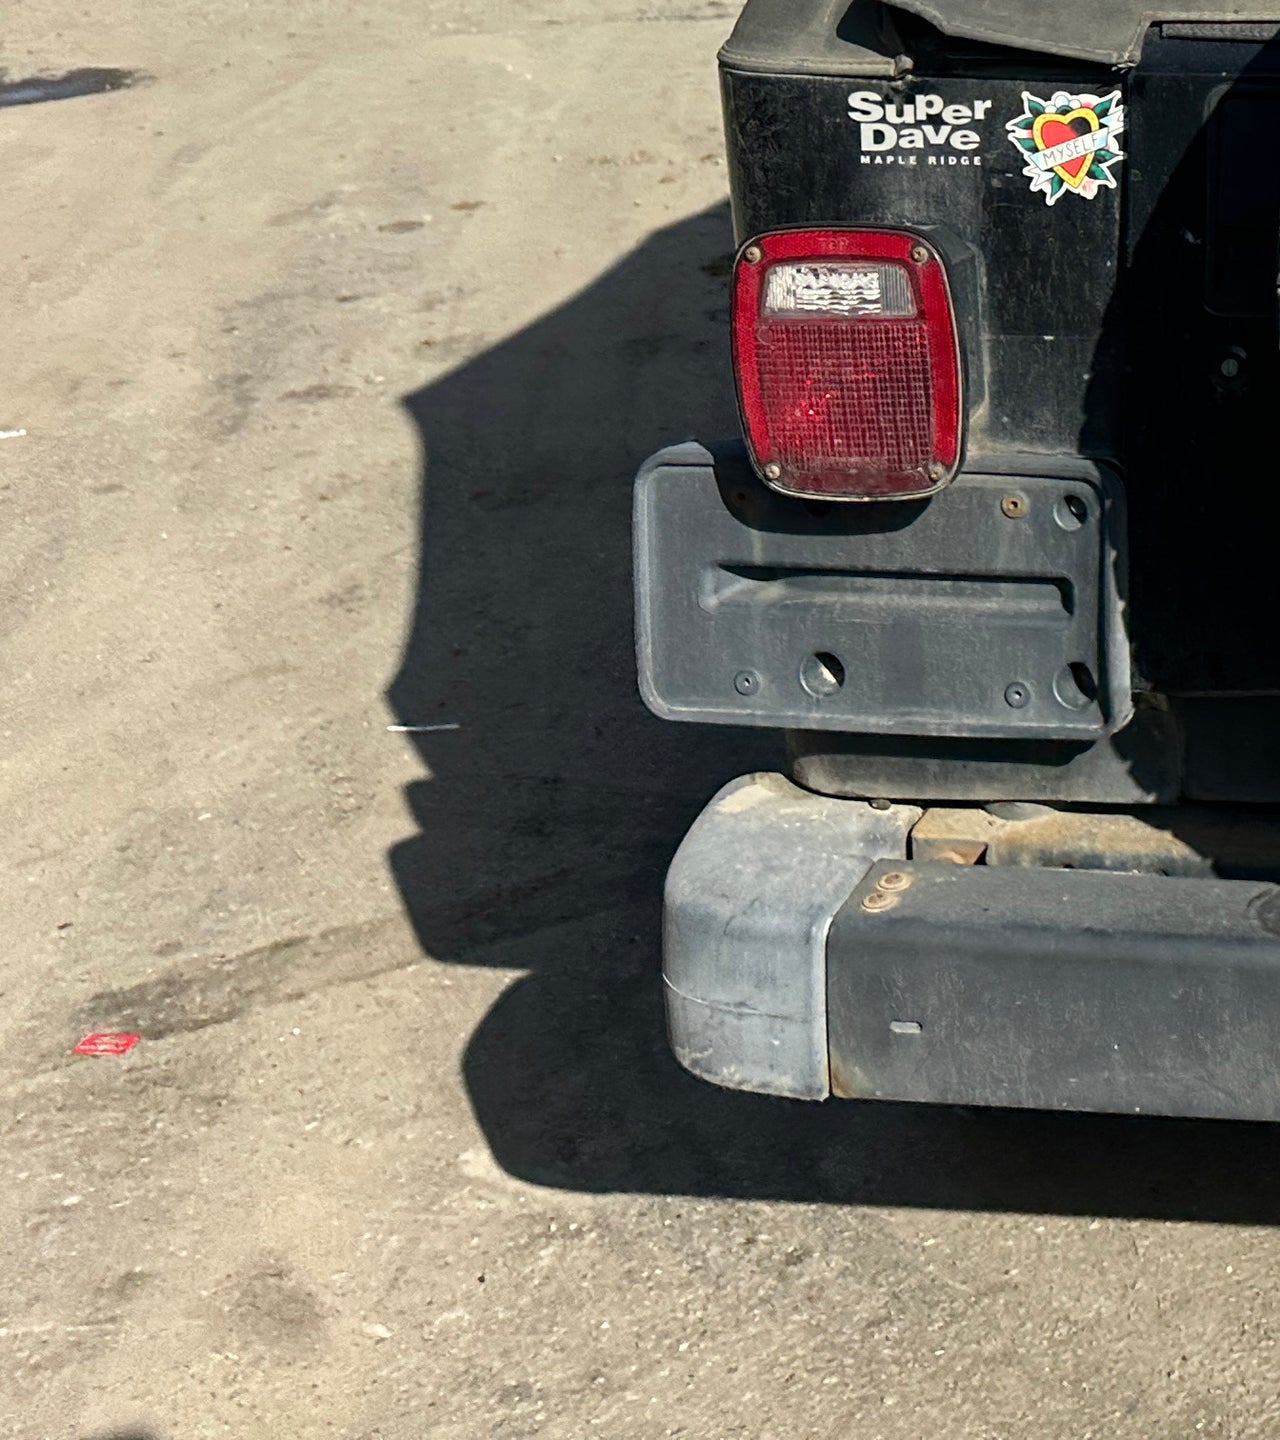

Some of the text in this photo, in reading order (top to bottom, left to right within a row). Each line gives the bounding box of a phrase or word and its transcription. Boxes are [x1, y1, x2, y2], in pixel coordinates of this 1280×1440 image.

[1043, 134, 1099, 166] MYSELF
[860, 156, 982, 166] MAPLE RIDGE
